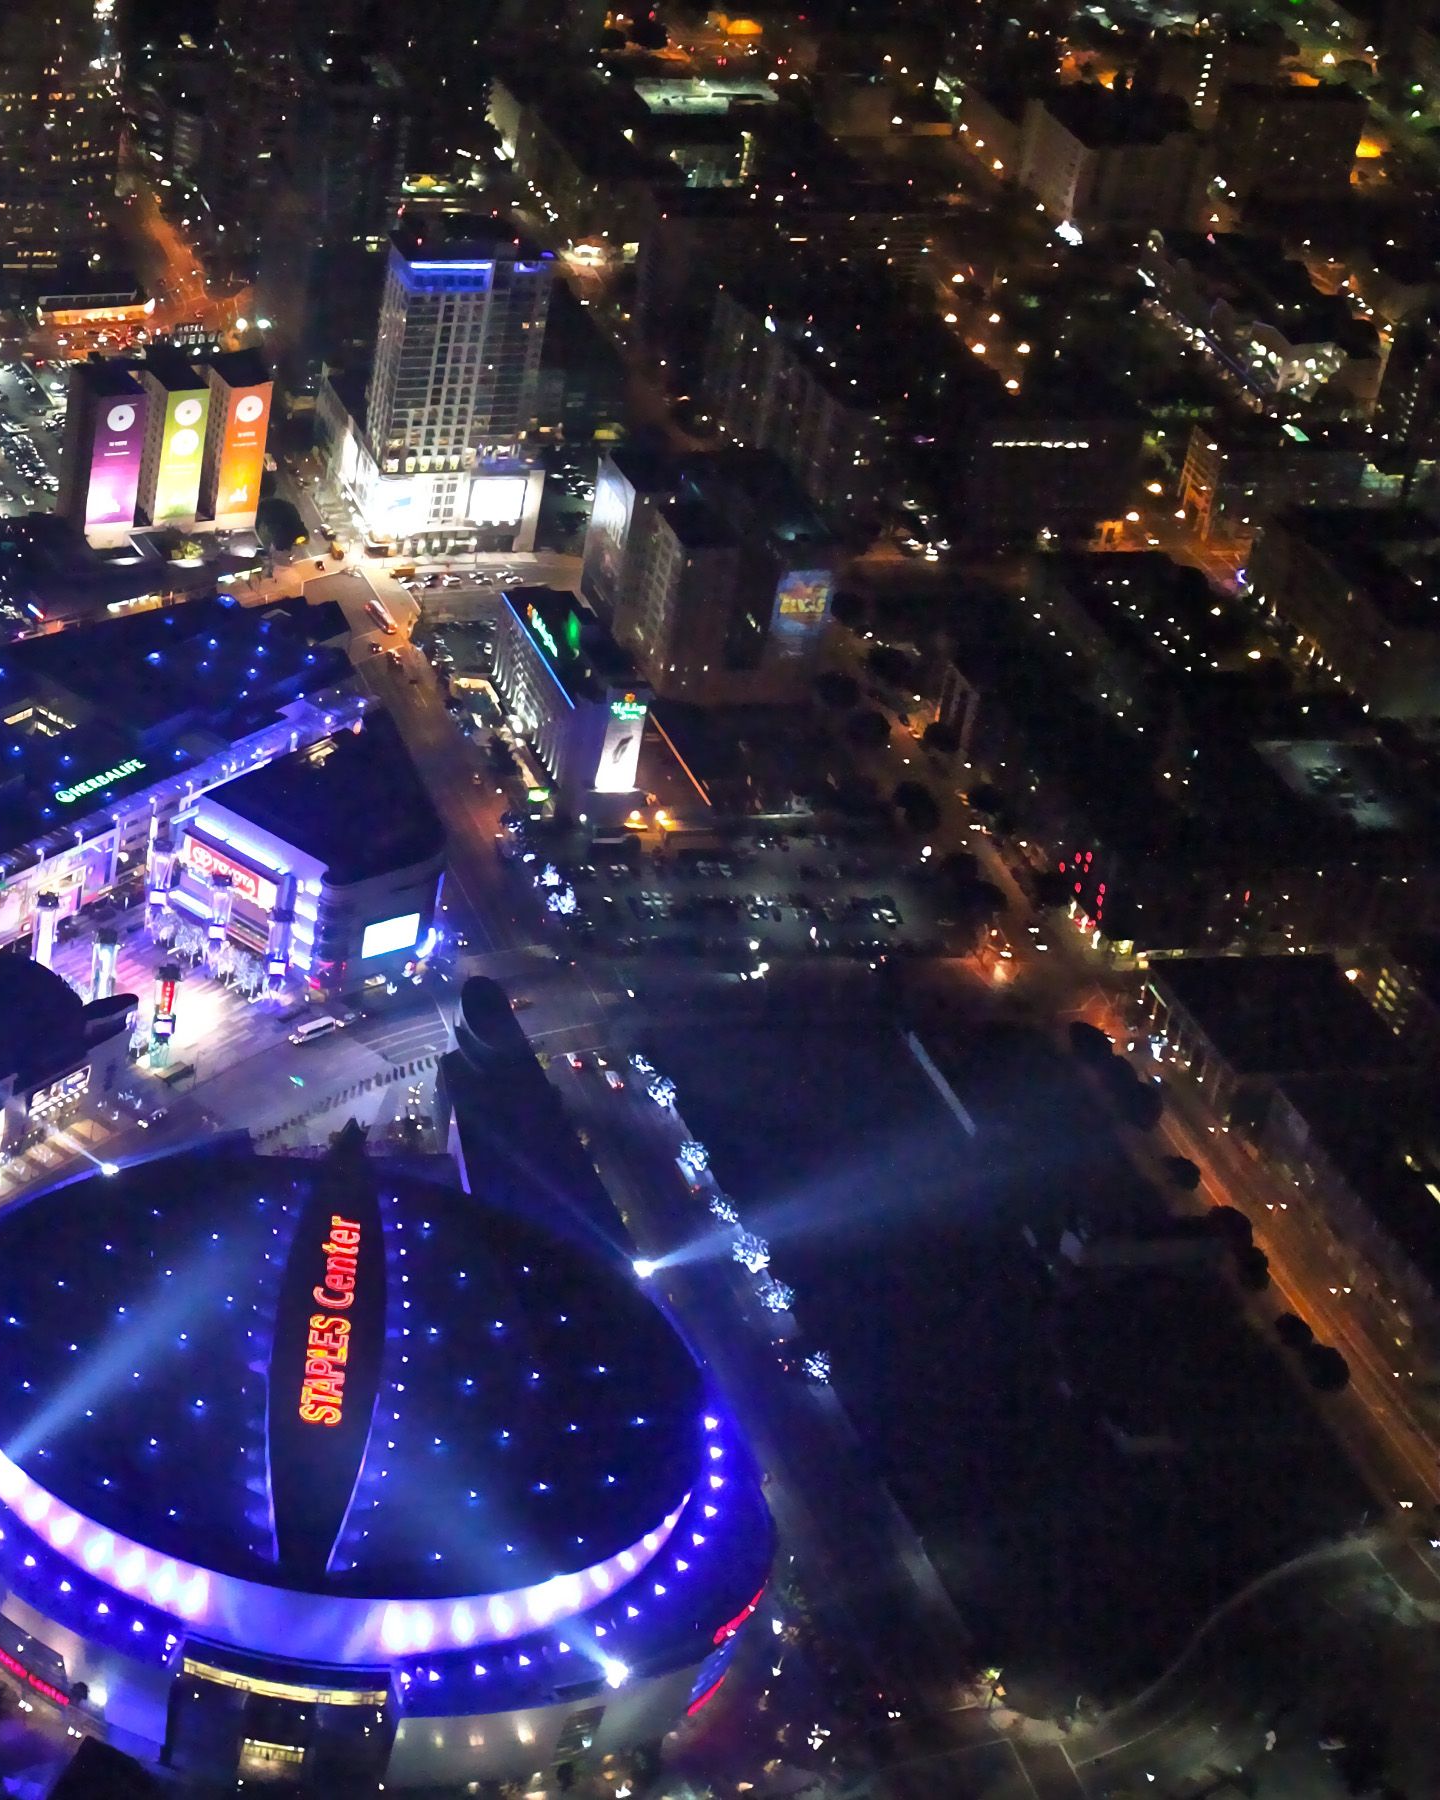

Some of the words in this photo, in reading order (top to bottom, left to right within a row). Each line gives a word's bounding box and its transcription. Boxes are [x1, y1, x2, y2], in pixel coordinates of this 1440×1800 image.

[68, 759, 146, 798] HERBALIFE
[212, 856, 257, 898] TOYOTA
[313, 1215, 361, 1310] Center
[299, 1313, 351, 1425] STAPLES
